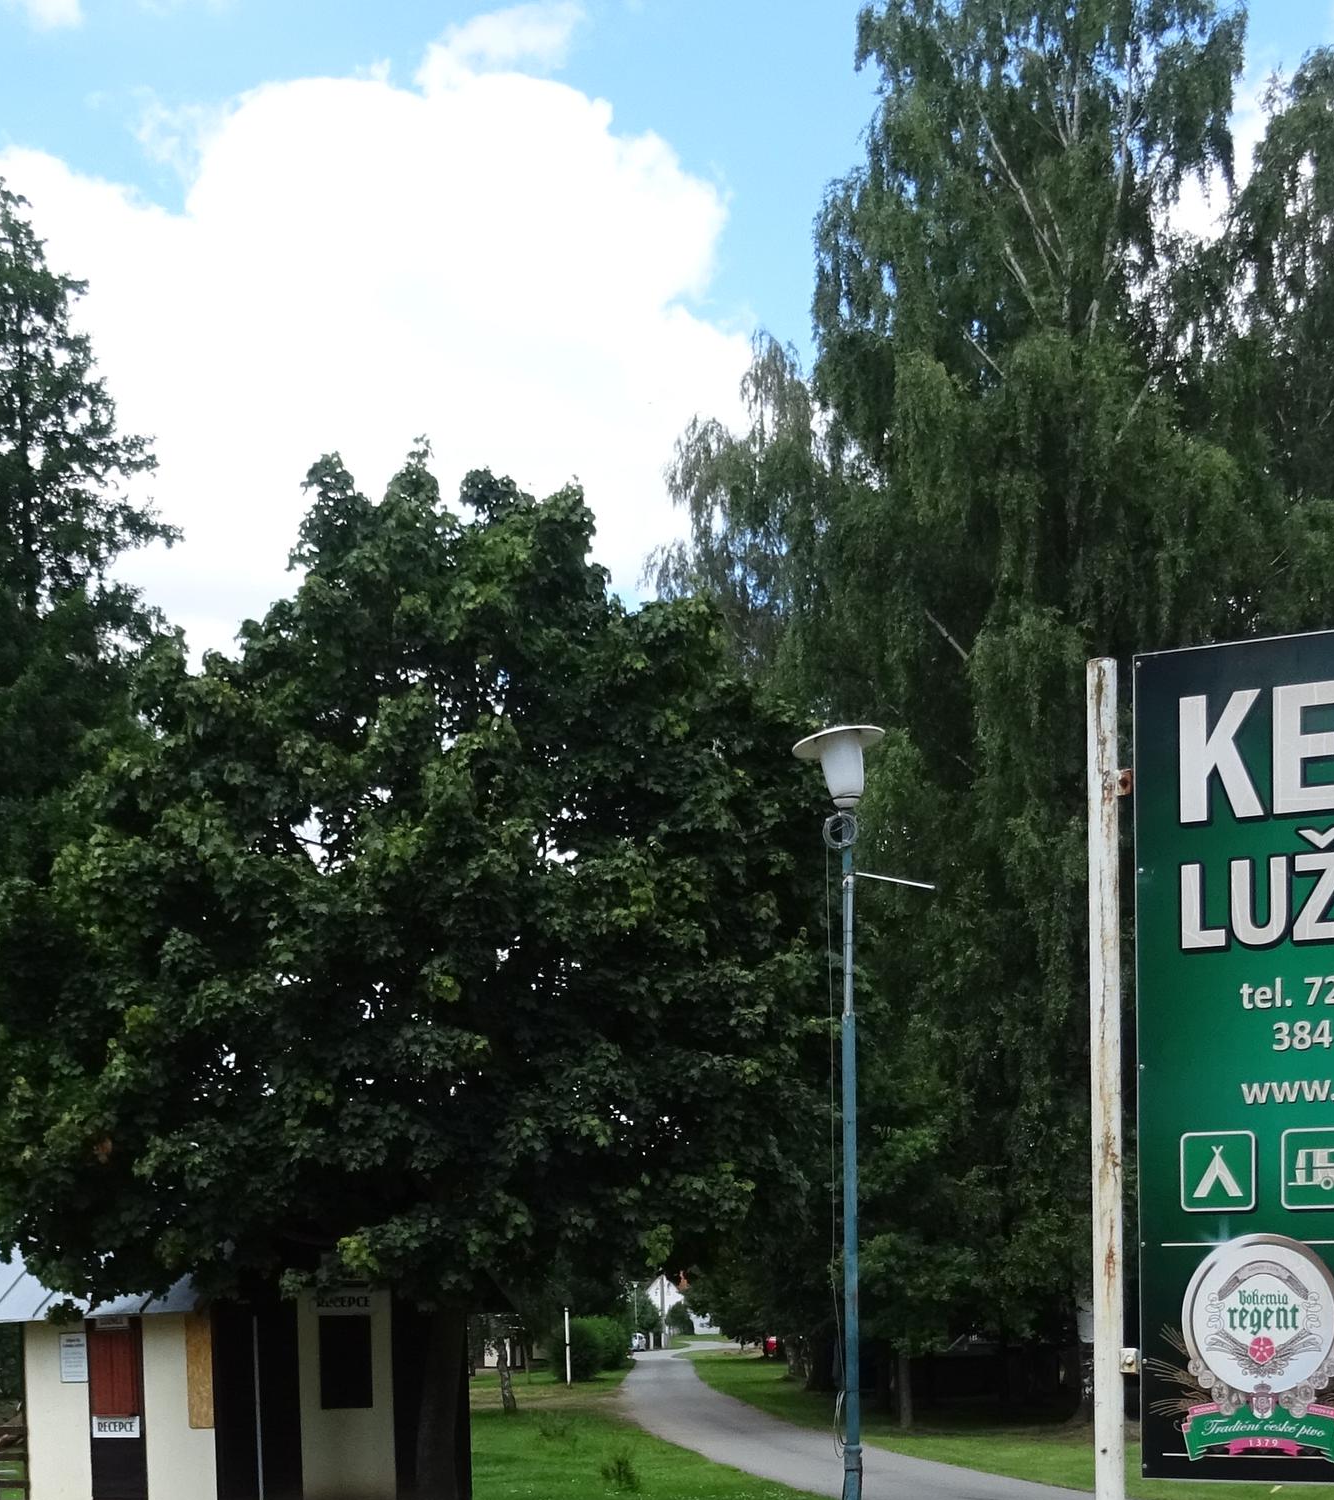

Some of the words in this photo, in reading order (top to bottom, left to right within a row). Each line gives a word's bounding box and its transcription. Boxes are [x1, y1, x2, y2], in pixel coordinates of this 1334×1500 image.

[1240, 981, 1293, 1010] tel.
[1272, 1020, 1333, 1051] 384
[1227, 1304, 1299, 1335] regent
[97, 1421, 135, 1433] RECEPCE
[1249, 1439, 1278, 1448] 1379
